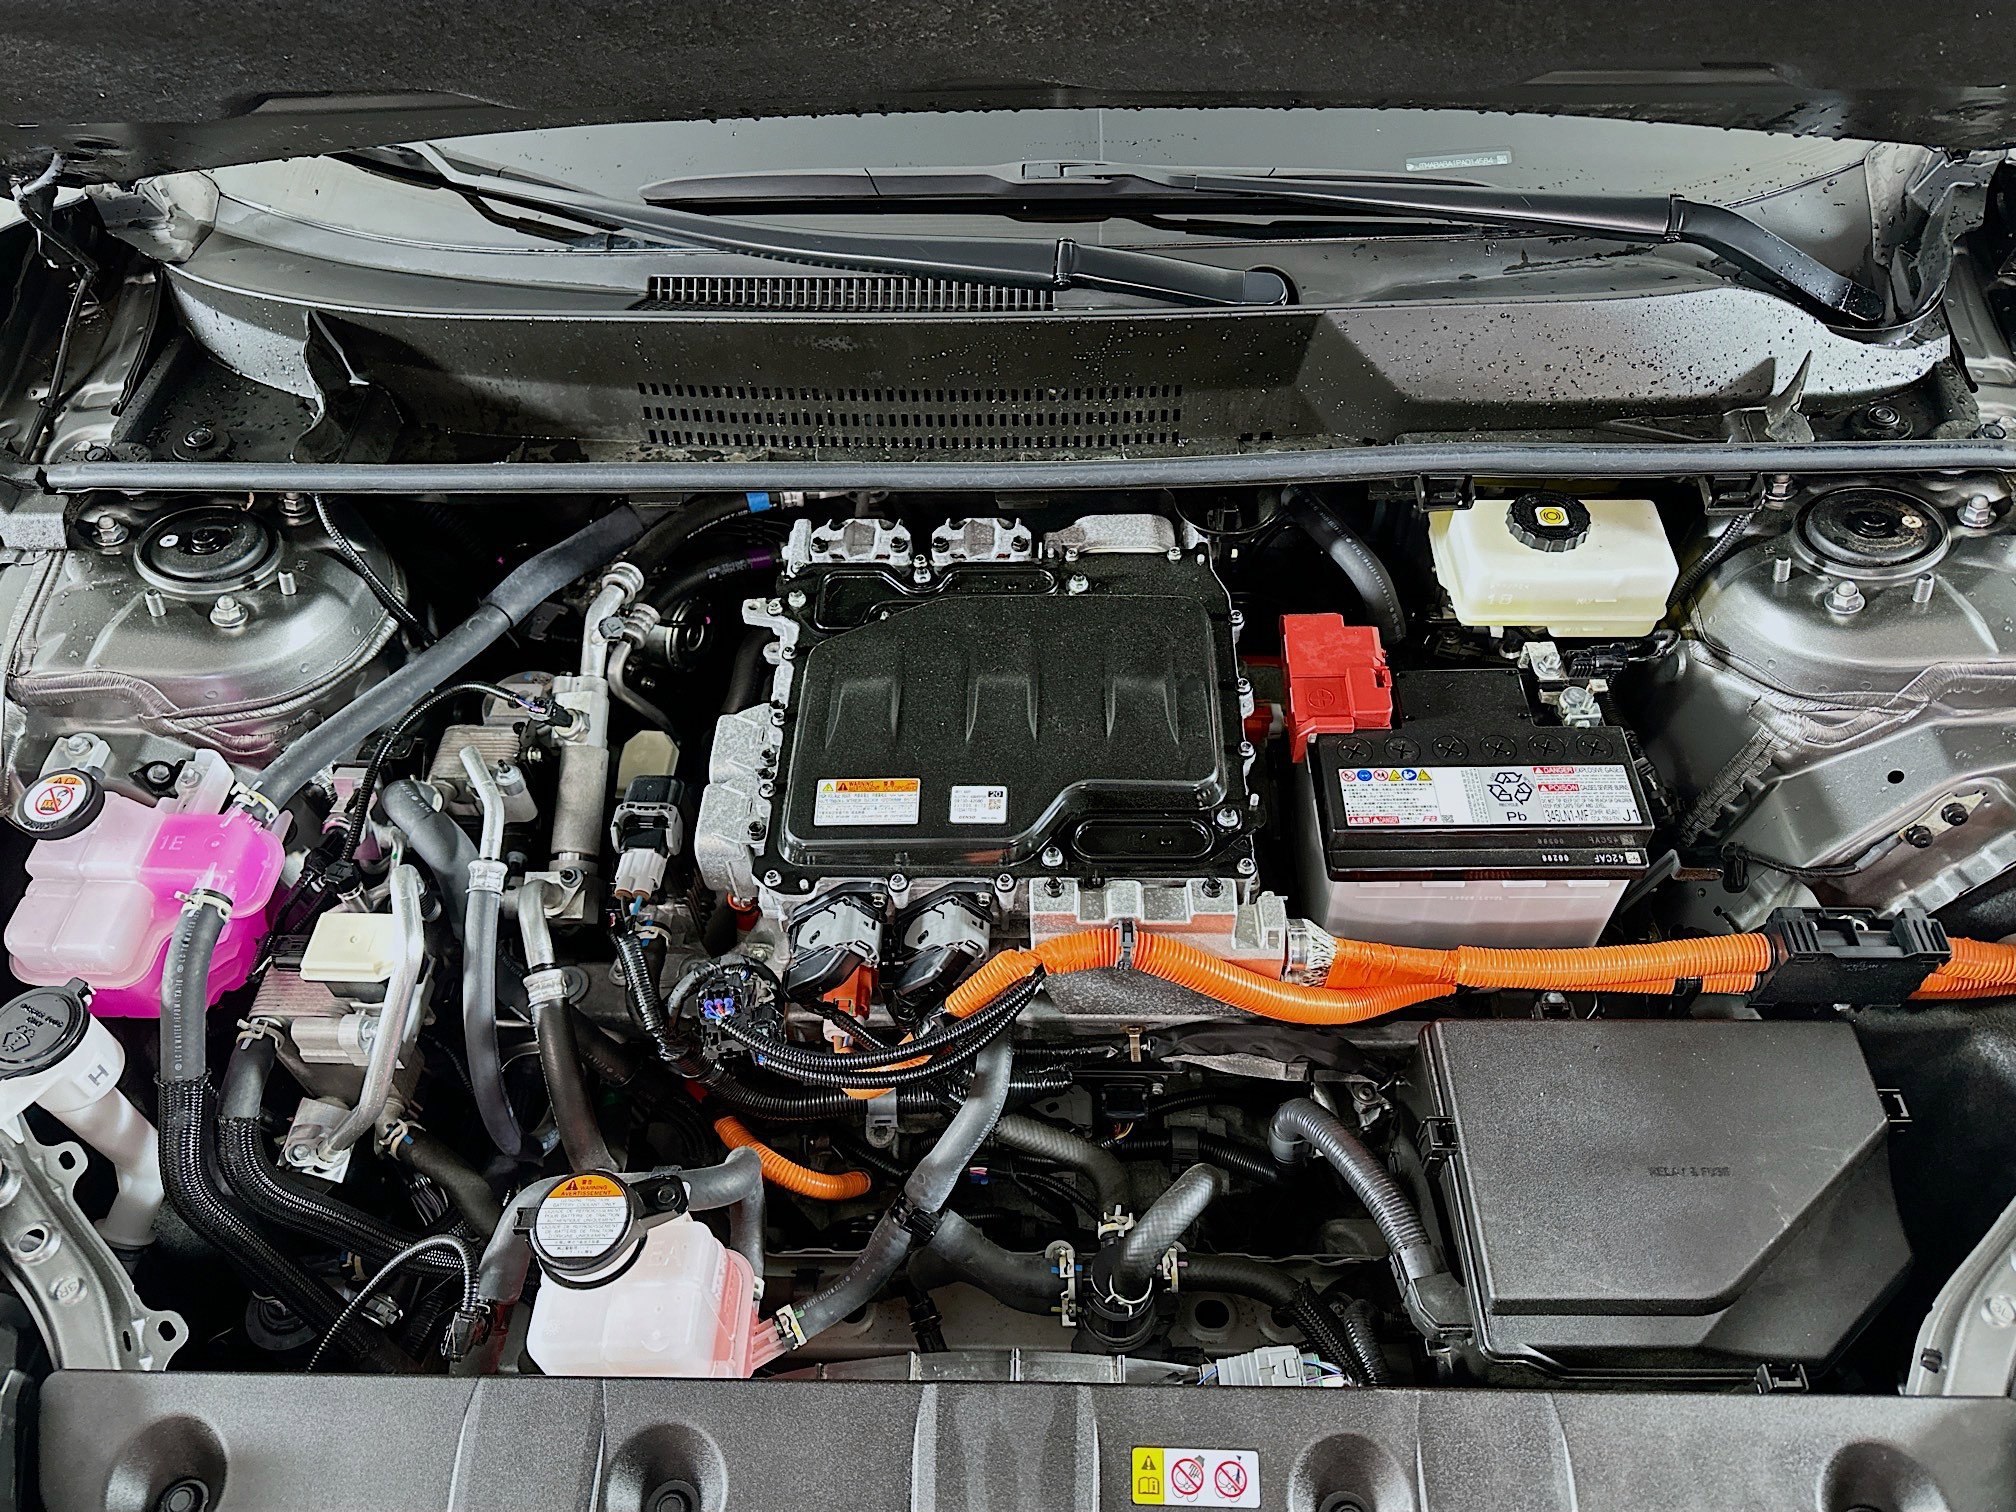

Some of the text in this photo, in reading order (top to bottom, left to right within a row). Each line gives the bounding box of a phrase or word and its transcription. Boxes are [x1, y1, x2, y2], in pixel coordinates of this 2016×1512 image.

[1506, 811, 1527, 821] Pb
[1622, 809, 1640, 822] J1
[159, 832, 186, 851] 1E
